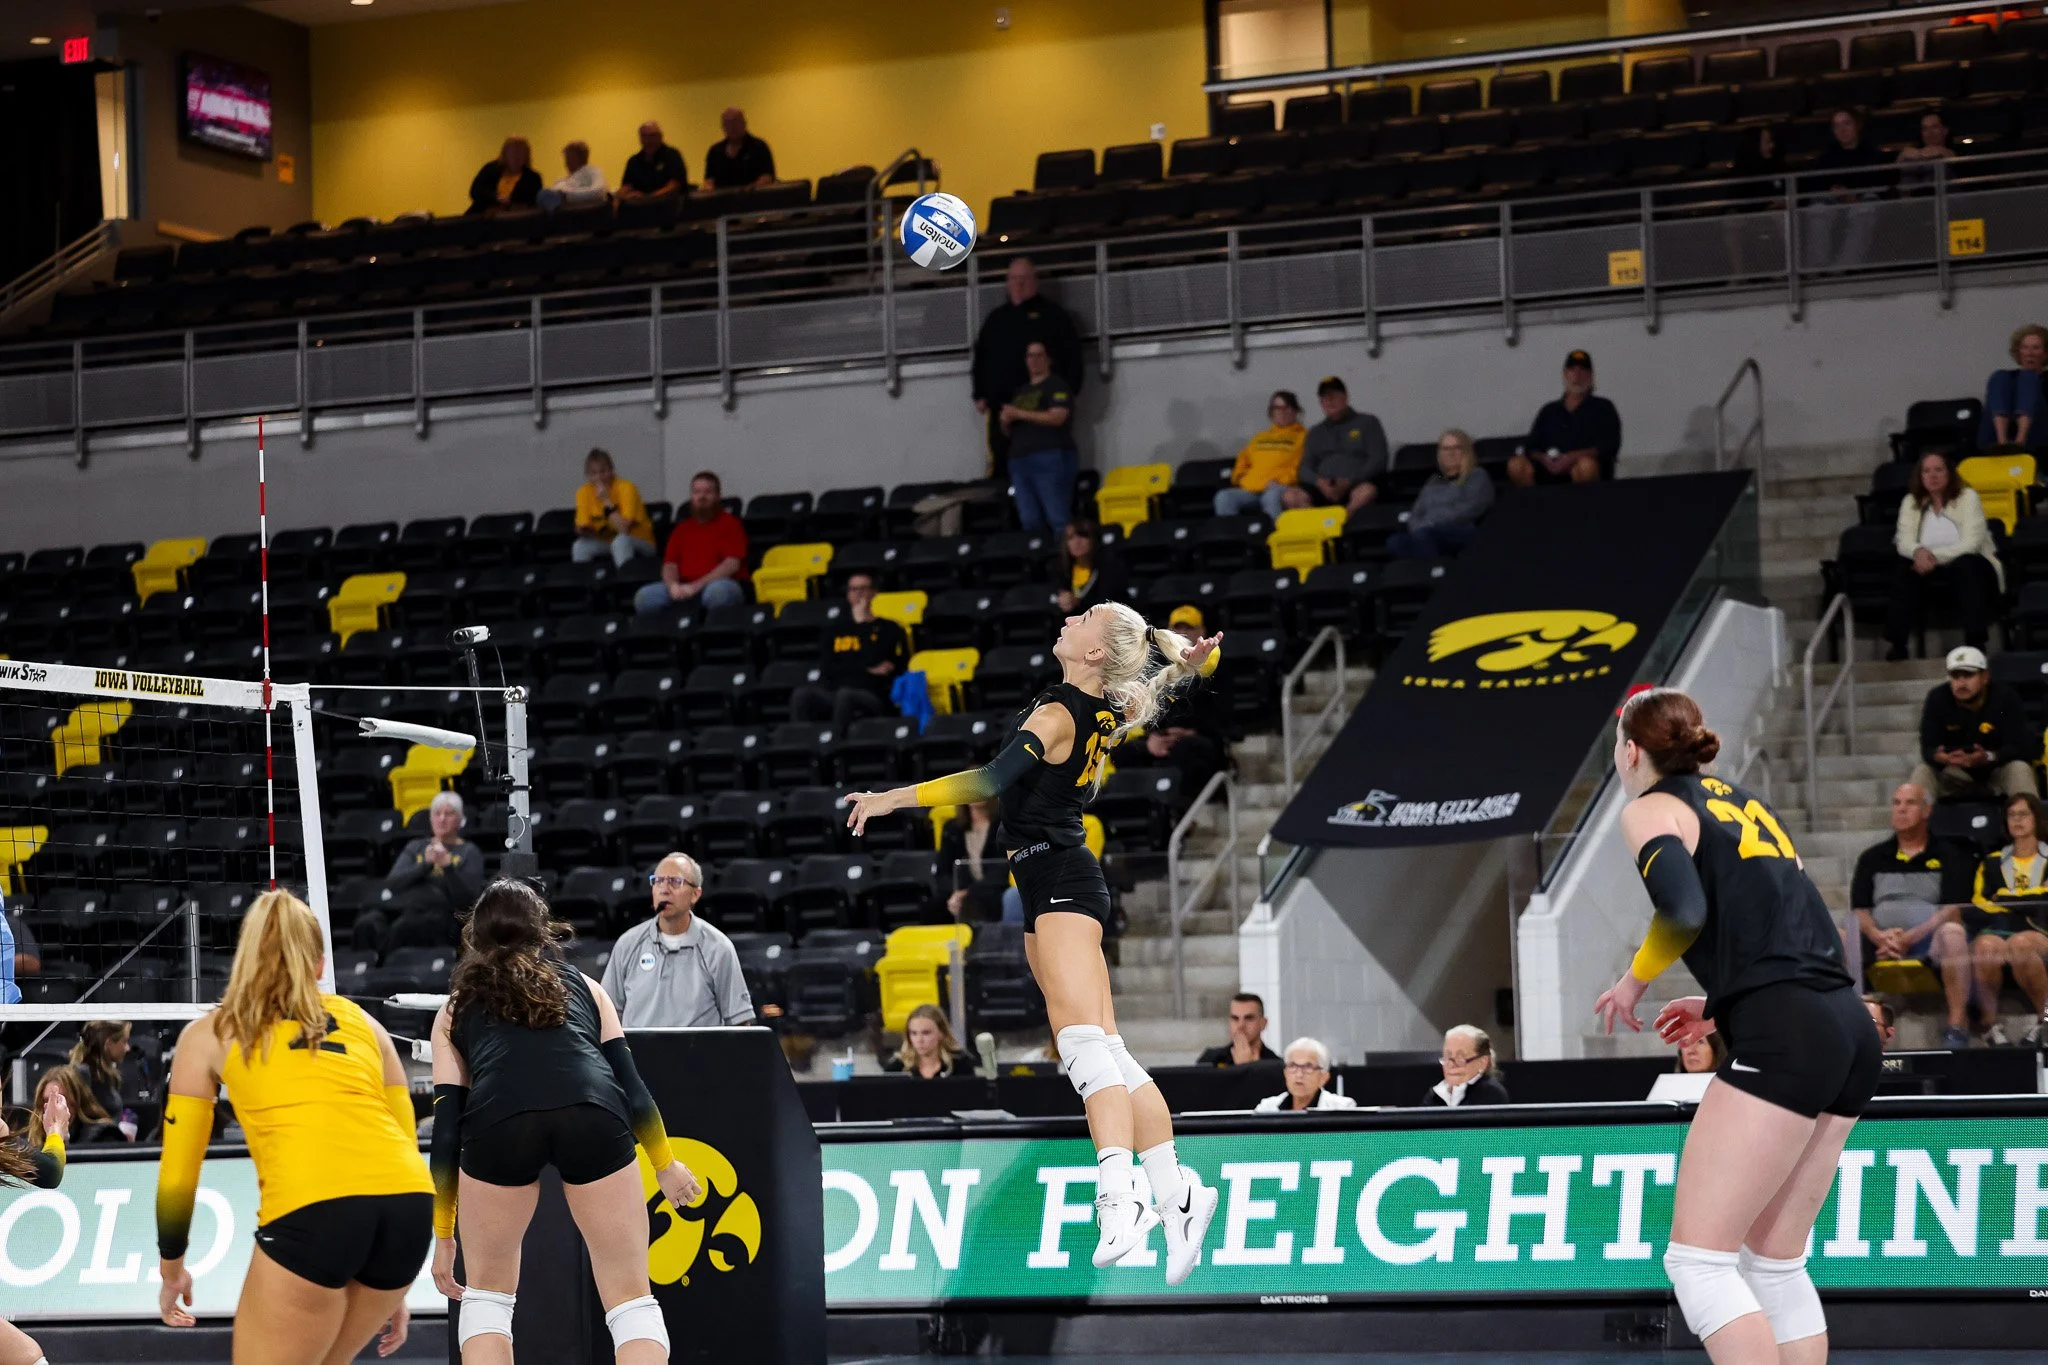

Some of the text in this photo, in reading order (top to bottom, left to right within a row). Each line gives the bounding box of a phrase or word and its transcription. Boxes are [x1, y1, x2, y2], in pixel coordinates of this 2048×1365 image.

[64, 36, 90, 63] EXIT
[920, 221, 958, 251] molten
[94, 669, 204, 697] IOWA VOLLEYBALL
[1402, 665, 1611, 689] IOWA HAWKEYES
[1706, 798, 1796, 860] 21
[1013, 841, 1050, 863] NIKE PRO
[1260, 1294, 1329, 1304] DAKTRONICS
